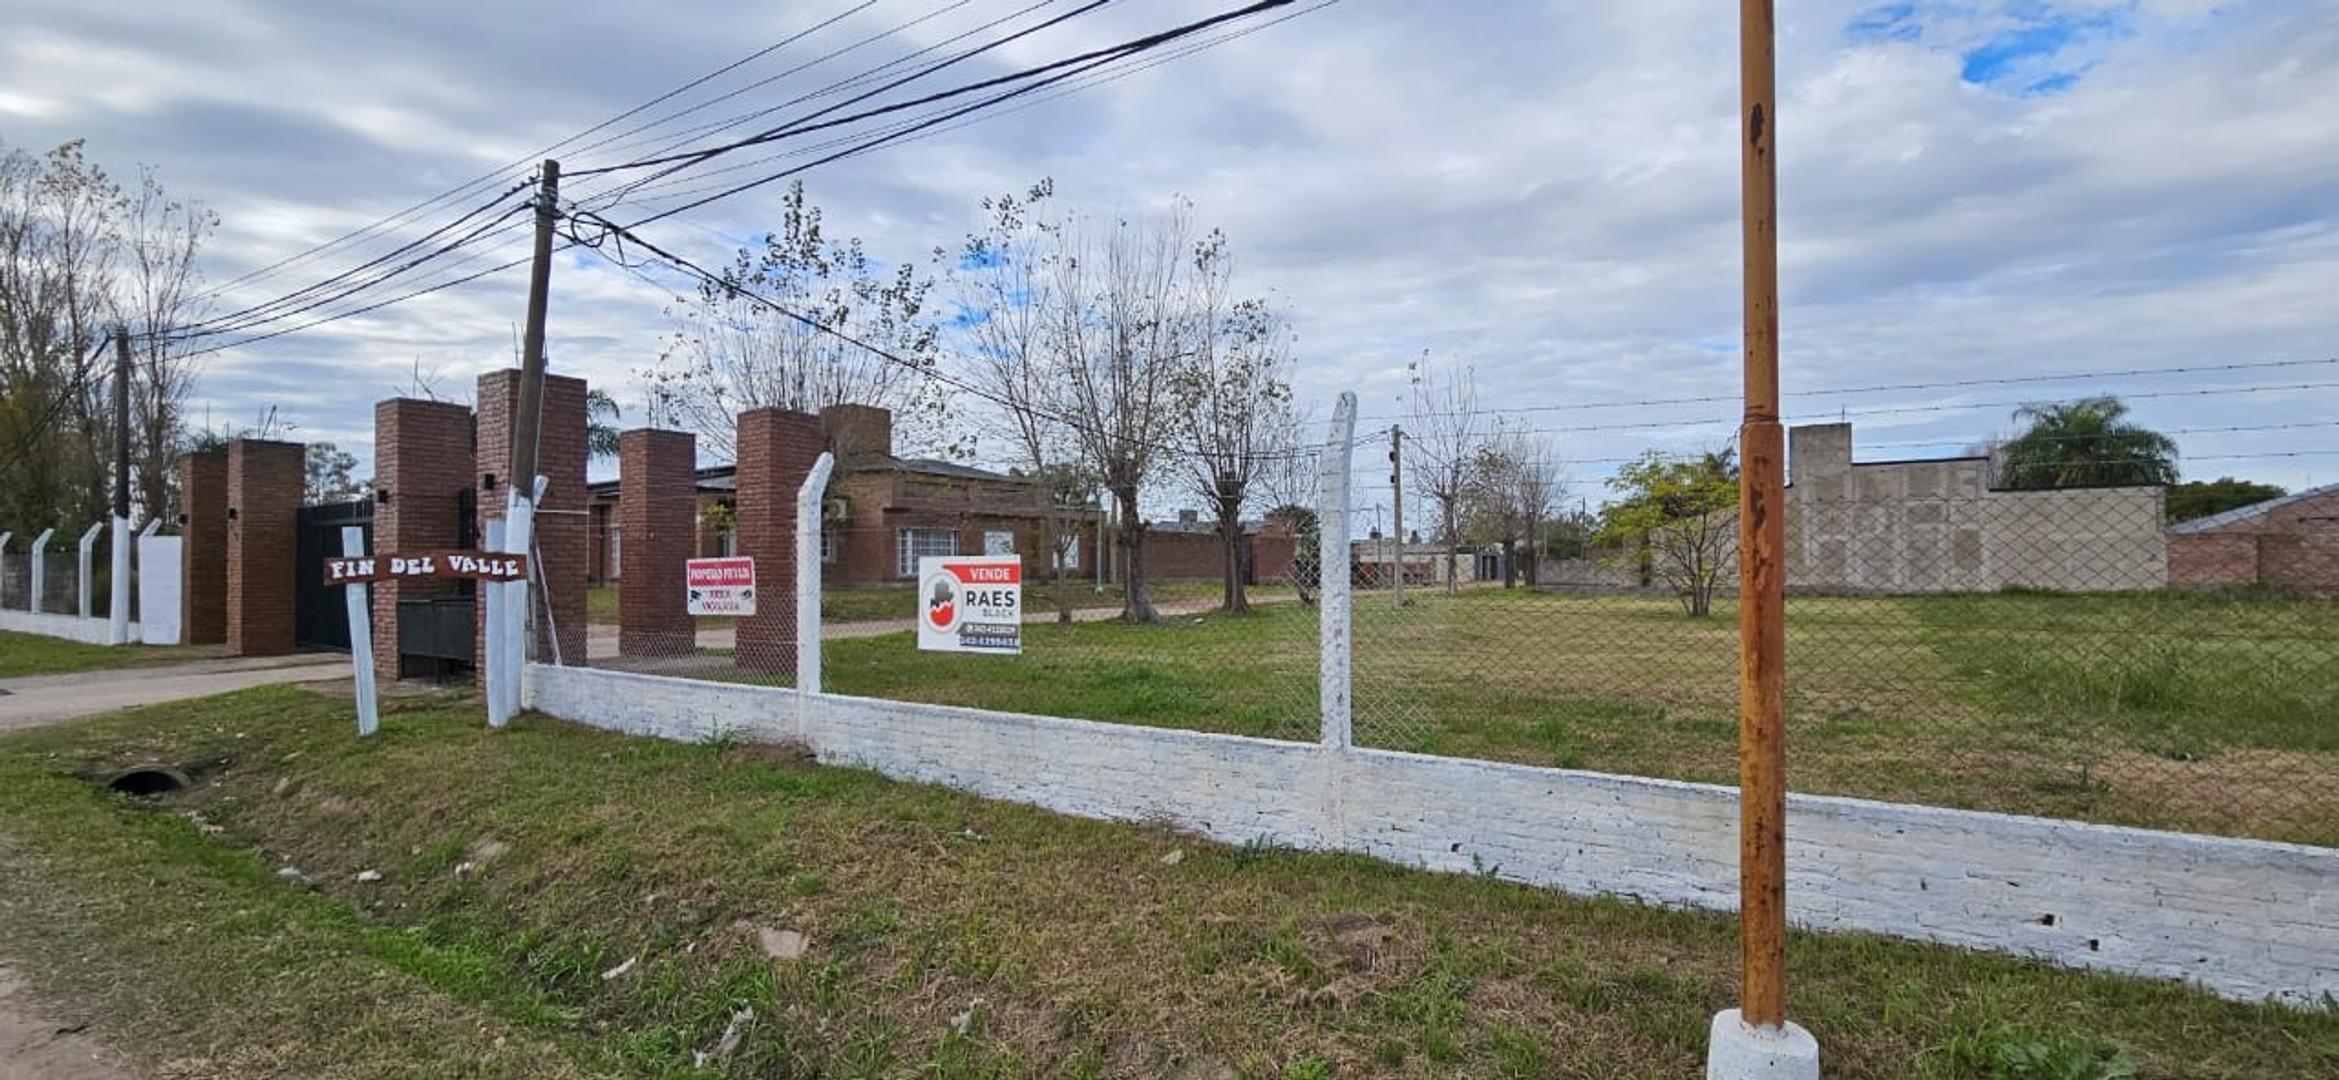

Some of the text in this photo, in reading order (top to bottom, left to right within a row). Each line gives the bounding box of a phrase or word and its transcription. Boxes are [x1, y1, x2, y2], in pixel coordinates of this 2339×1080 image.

[330, 555, 520, 579] FIN DEL VALLE
[969, 567, 1011, 581] VENDE
[966, 590, 1015, 607] RAES
